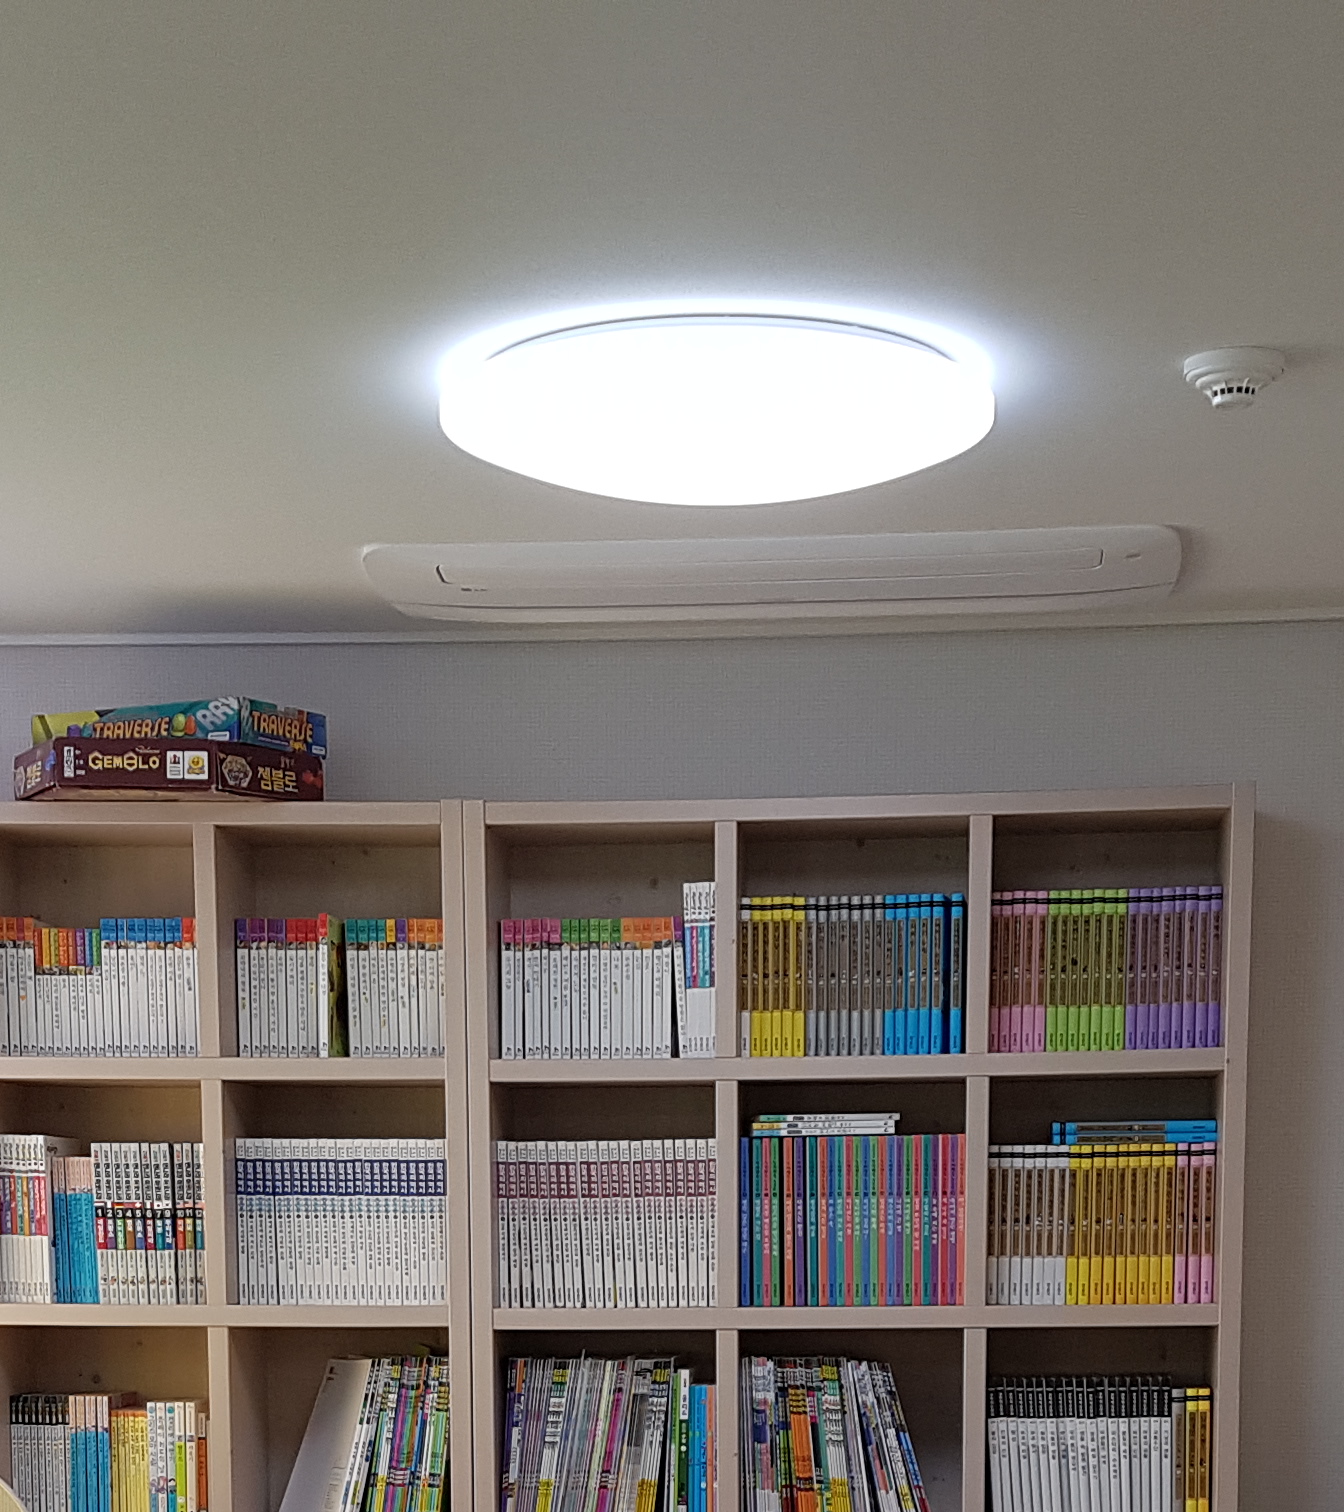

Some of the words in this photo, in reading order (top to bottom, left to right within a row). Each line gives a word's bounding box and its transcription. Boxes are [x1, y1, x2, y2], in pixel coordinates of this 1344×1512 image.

[93, 716, 170, 739] TRAVERSE
[252, 711, 313, 742] TRAVERSE
[257, 766, 298, 793] 젬블로
